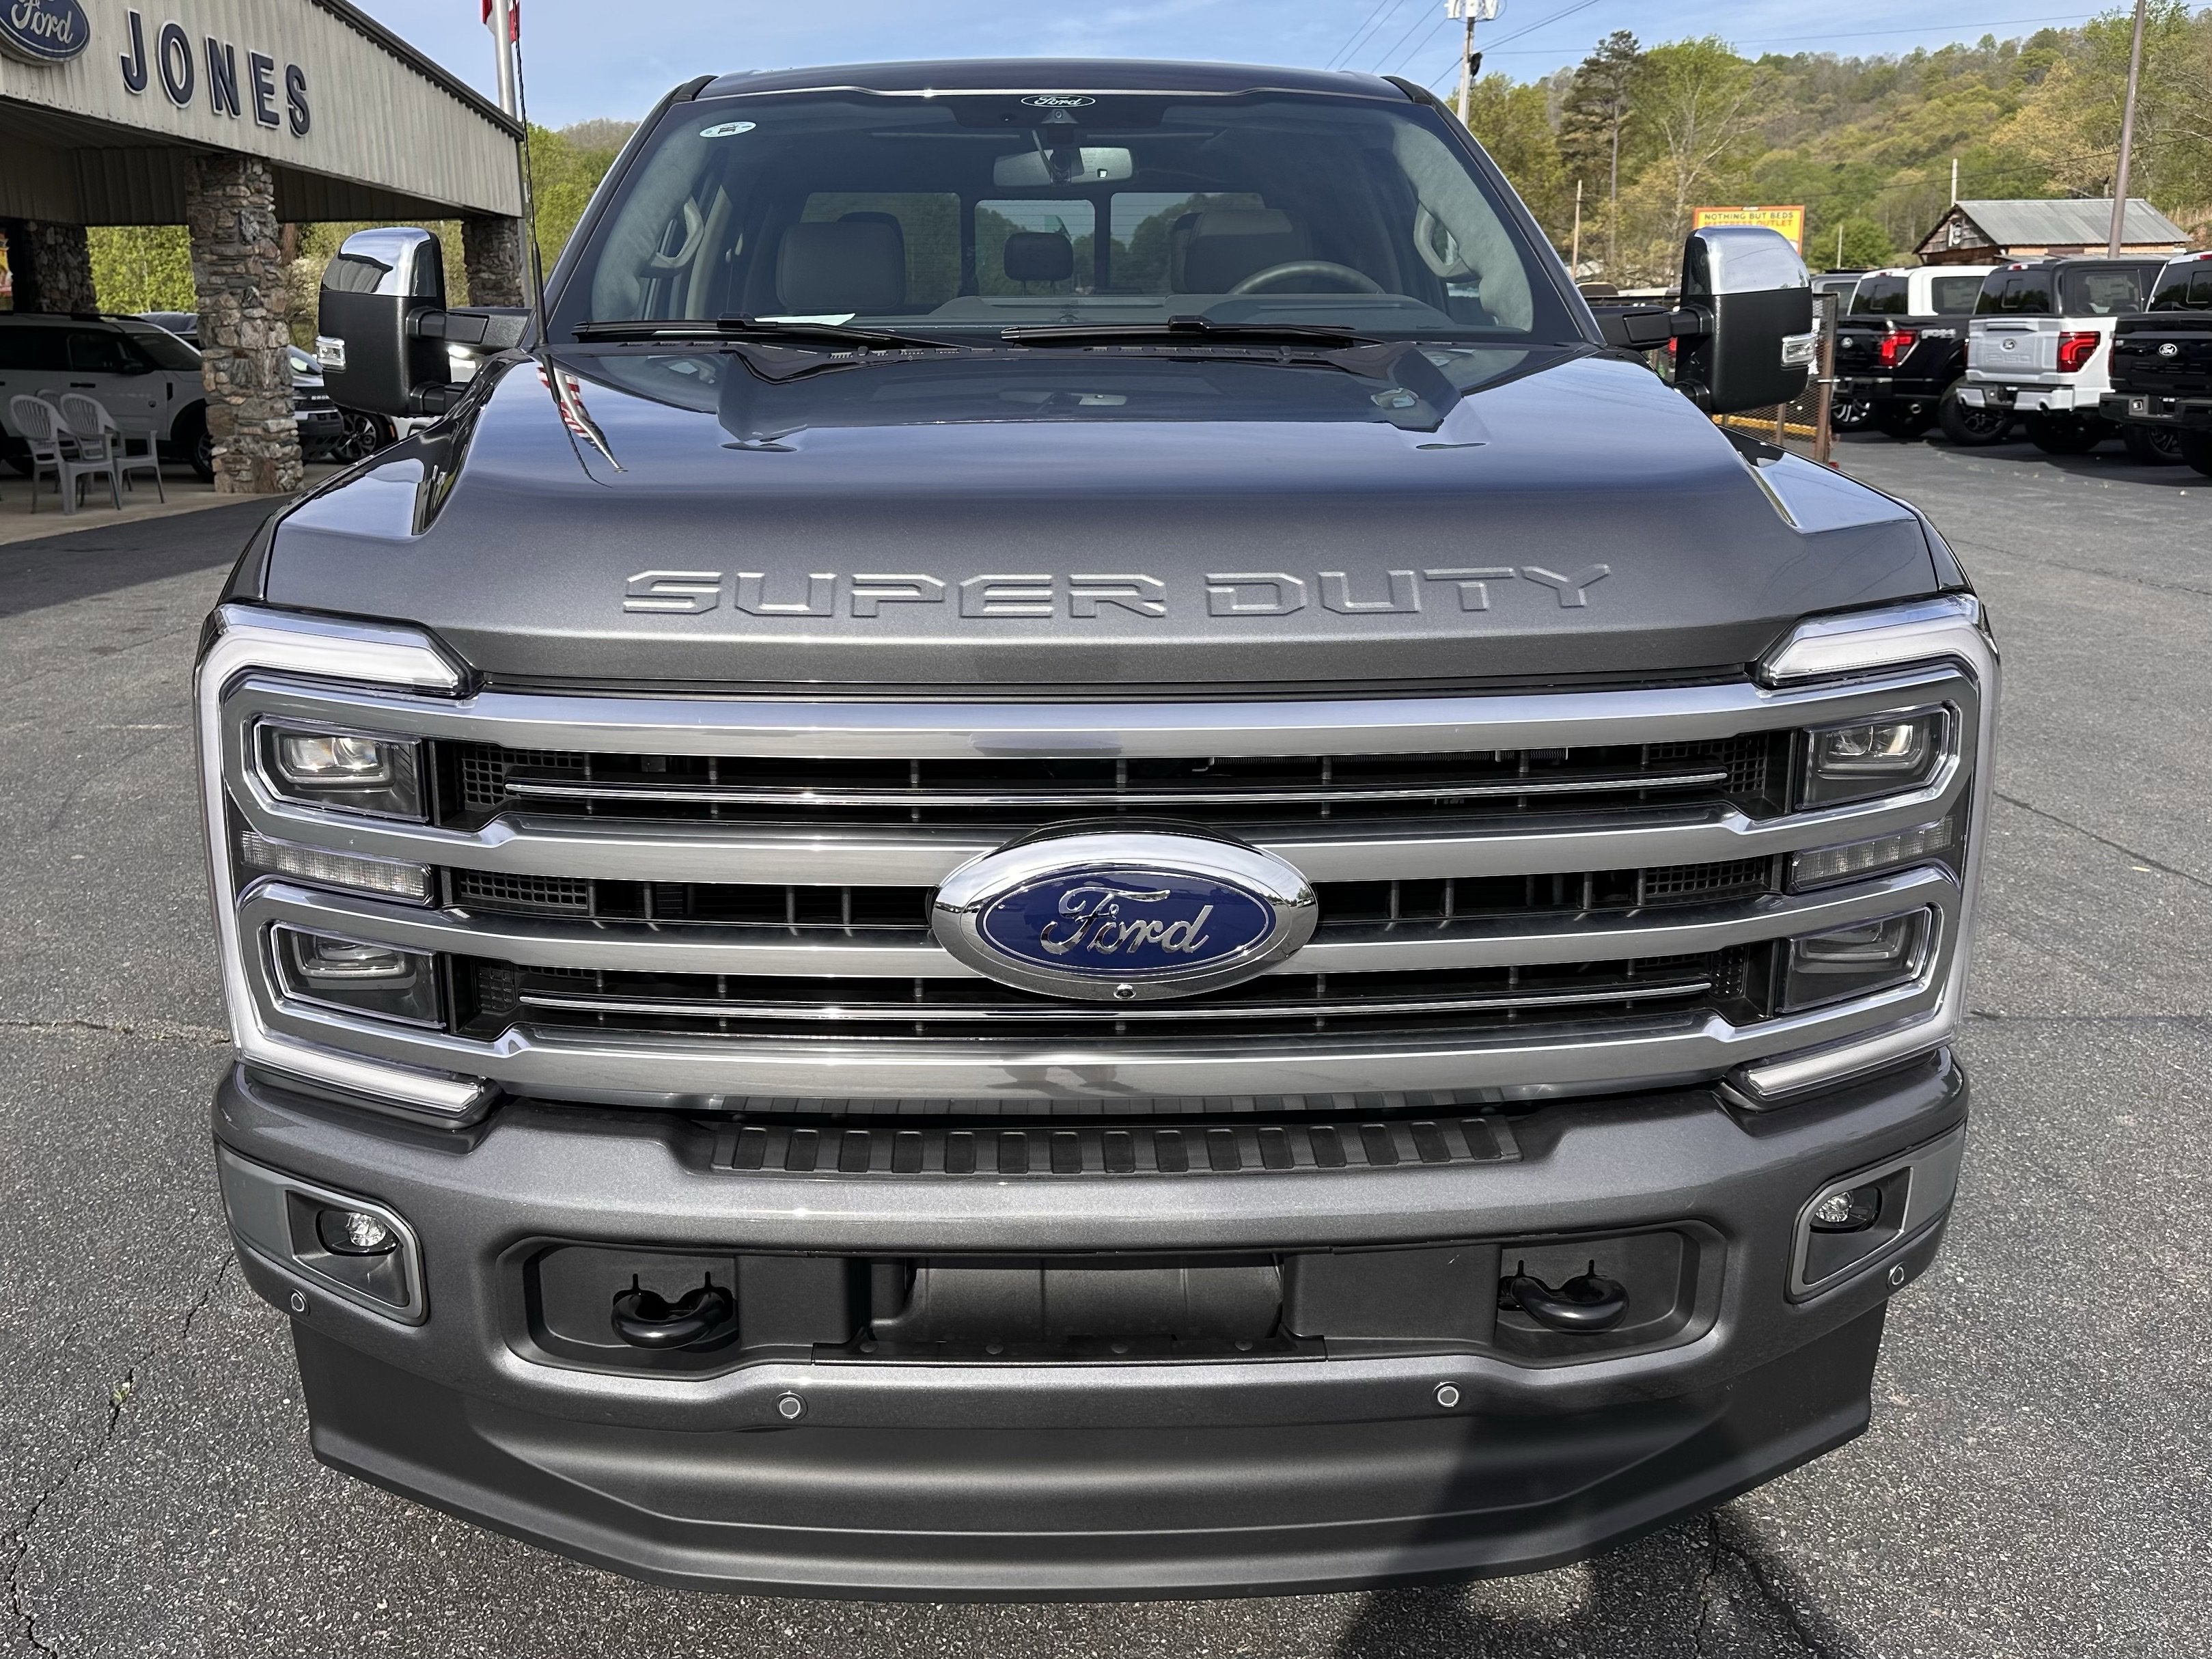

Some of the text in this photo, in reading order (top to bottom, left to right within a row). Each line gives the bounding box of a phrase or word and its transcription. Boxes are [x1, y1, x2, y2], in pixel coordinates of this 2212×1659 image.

[118, 8, 311, 137] JONES
[1034, 96, 1083, 105] Ford
[1770, 211, 1794, 219] BEDS
[623, 564, 1611, 618] SUPER DUTY
[1040, 886, 1213, 954] Ford
